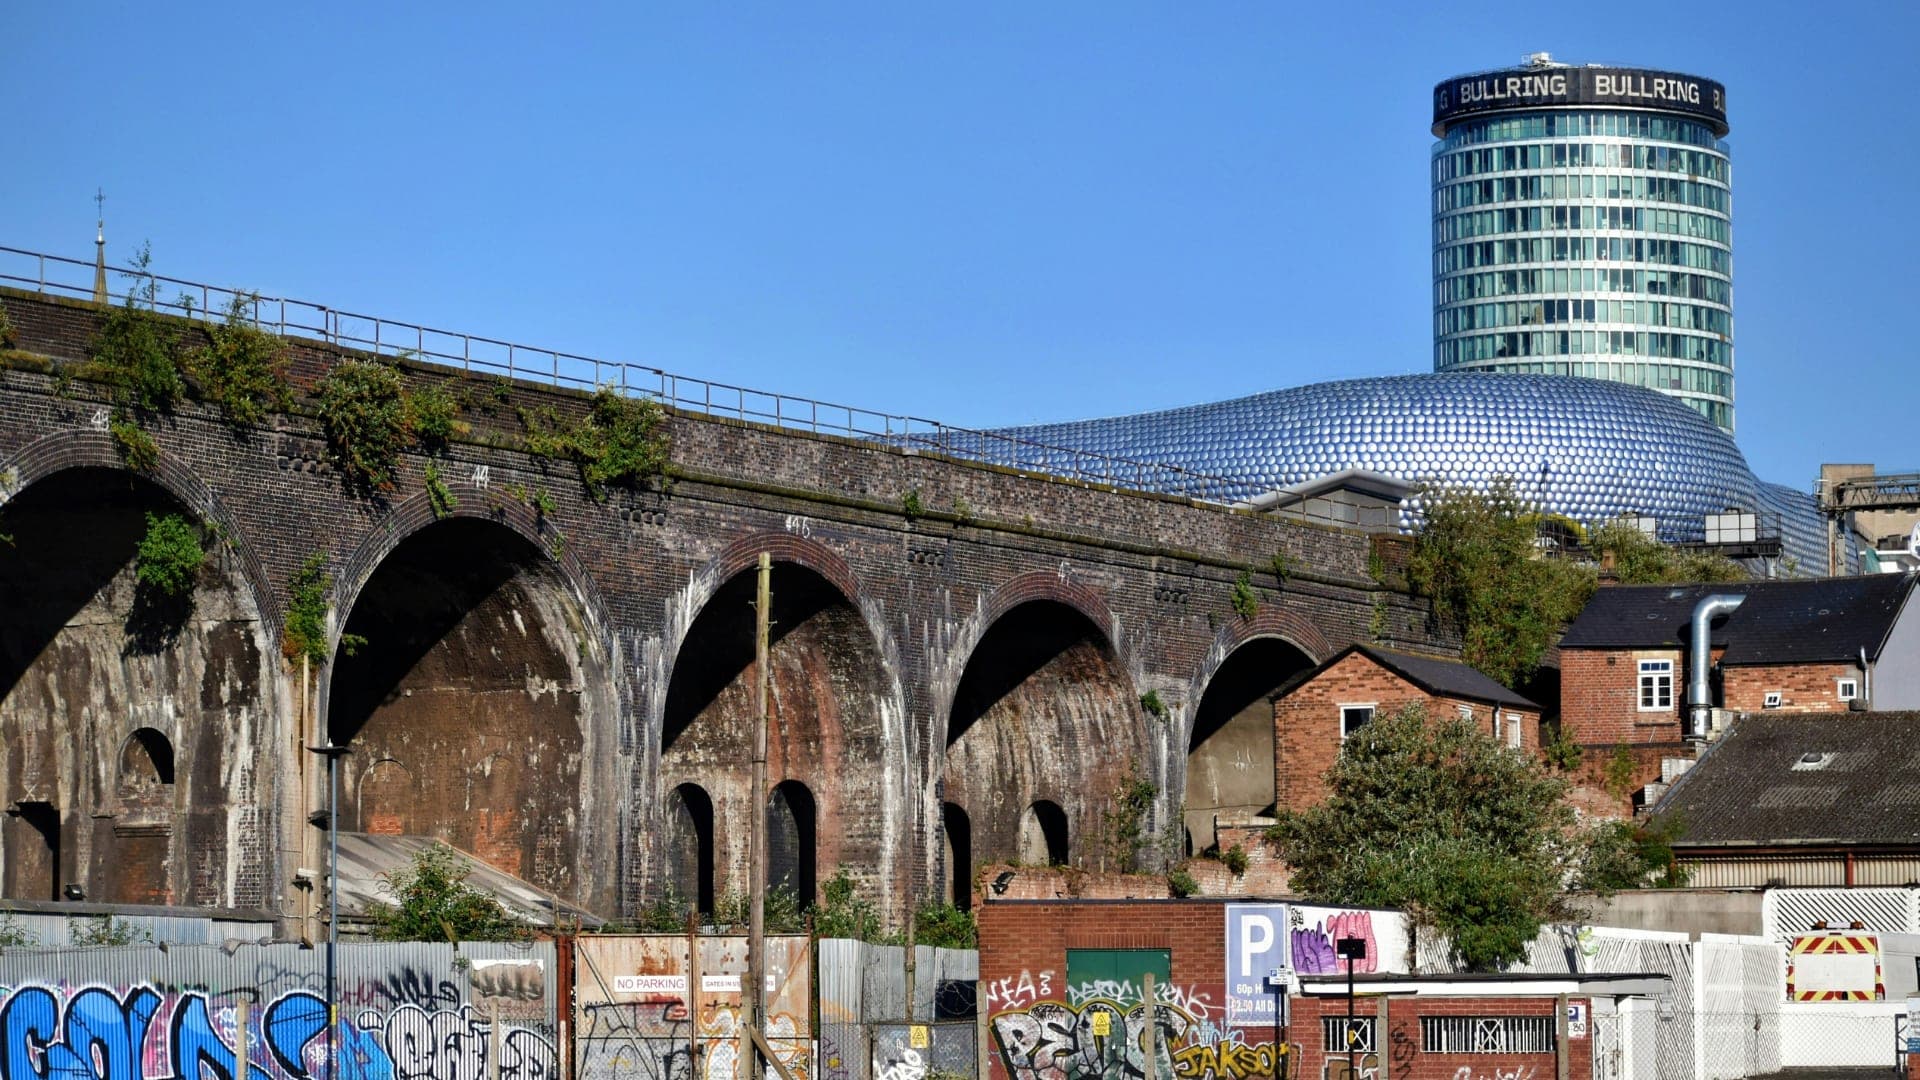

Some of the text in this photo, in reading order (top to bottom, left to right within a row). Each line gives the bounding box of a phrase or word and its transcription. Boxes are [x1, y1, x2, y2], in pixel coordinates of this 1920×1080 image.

[1460, 75, 1567, 104] BULLRING
[1595, 75, 1700, 104] BULLRING
[1241, 914, 1274, 976] P
[617, 979, 685, 989] NO PARKING
[1236, 984, 1253, 996] 60p
[1255, 1000, 1266, 1012] All
